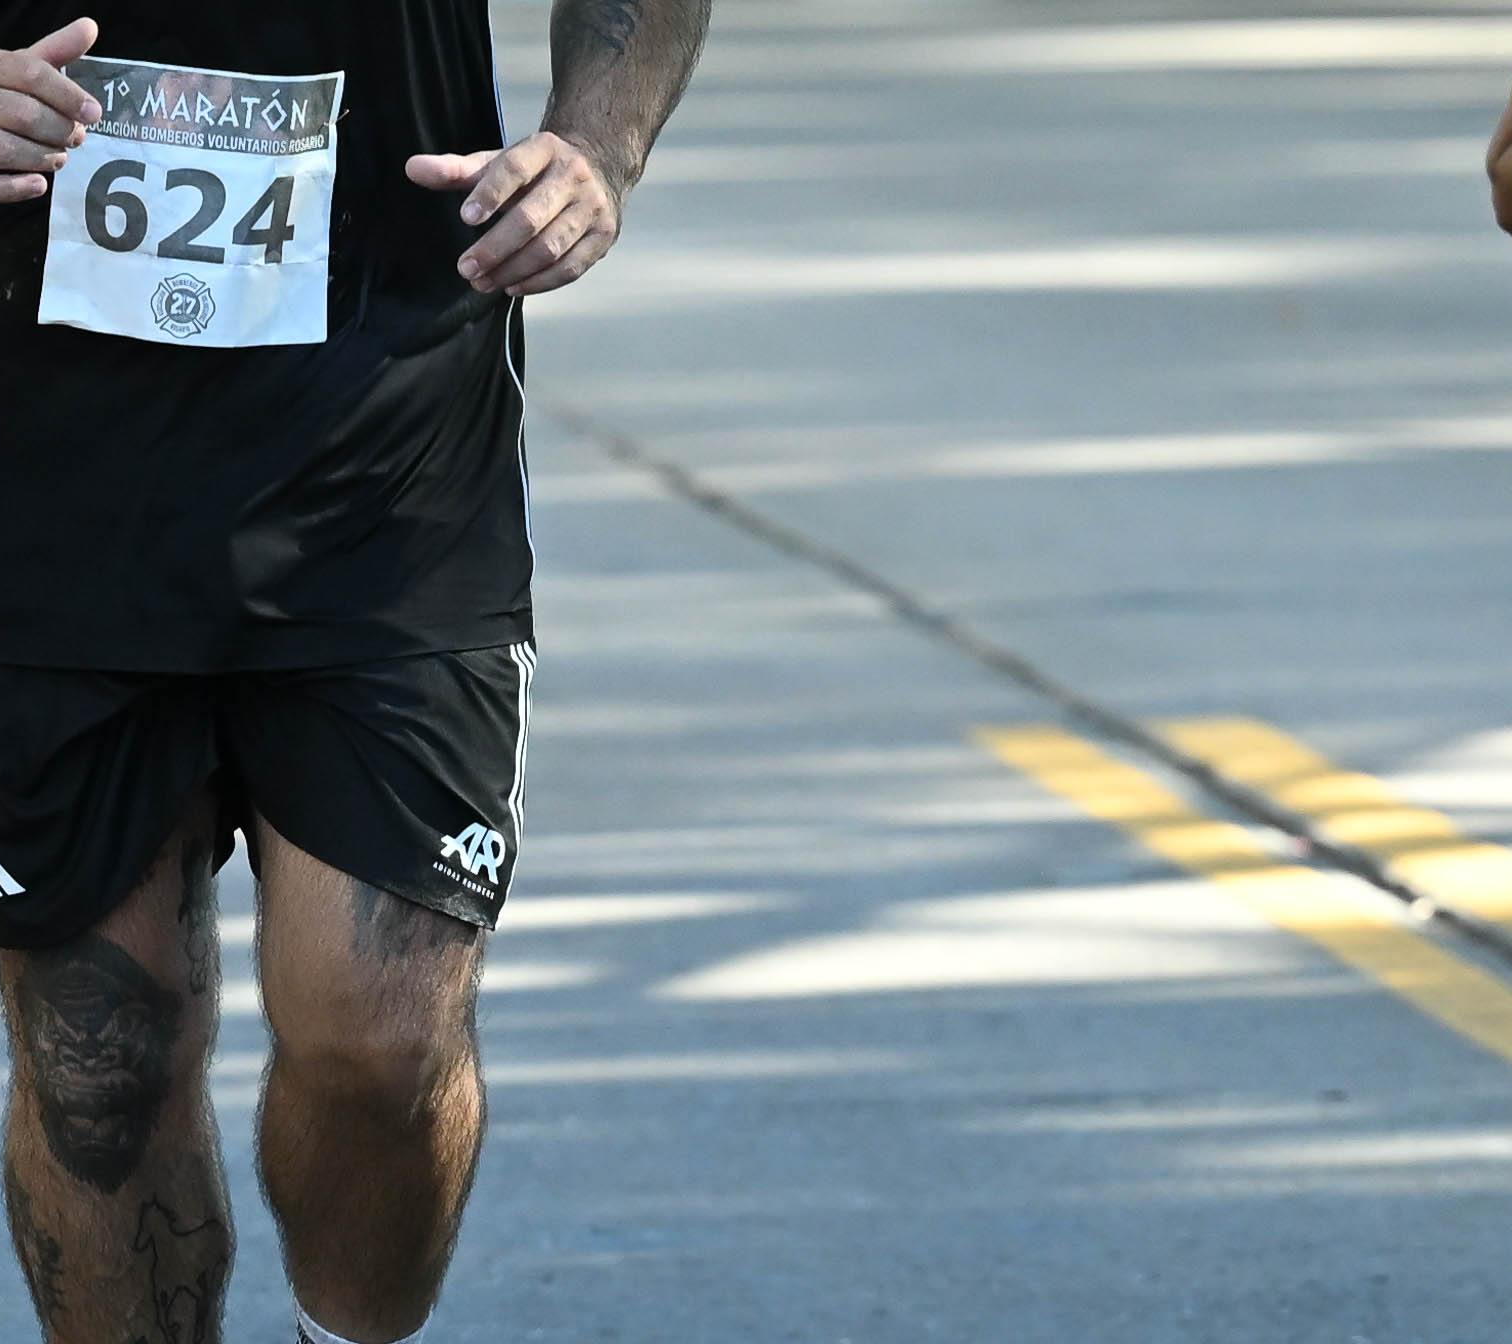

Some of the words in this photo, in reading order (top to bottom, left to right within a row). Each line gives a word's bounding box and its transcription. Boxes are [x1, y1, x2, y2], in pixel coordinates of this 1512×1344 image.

[139, 84, 308, 132] MARATÓN
[84, 120, 138, 138] OCIACIÓN
[141, 126, 205, 147] BOMBEROS
[207, 134, 287, 154] VOLUNTARIOS
[289, 134, 325, 152] ROSARIO
[84, 158, 296, 264] 624
[170, 292, 197, 315] 27
[432, 861, 461, 882] ADIDAS
